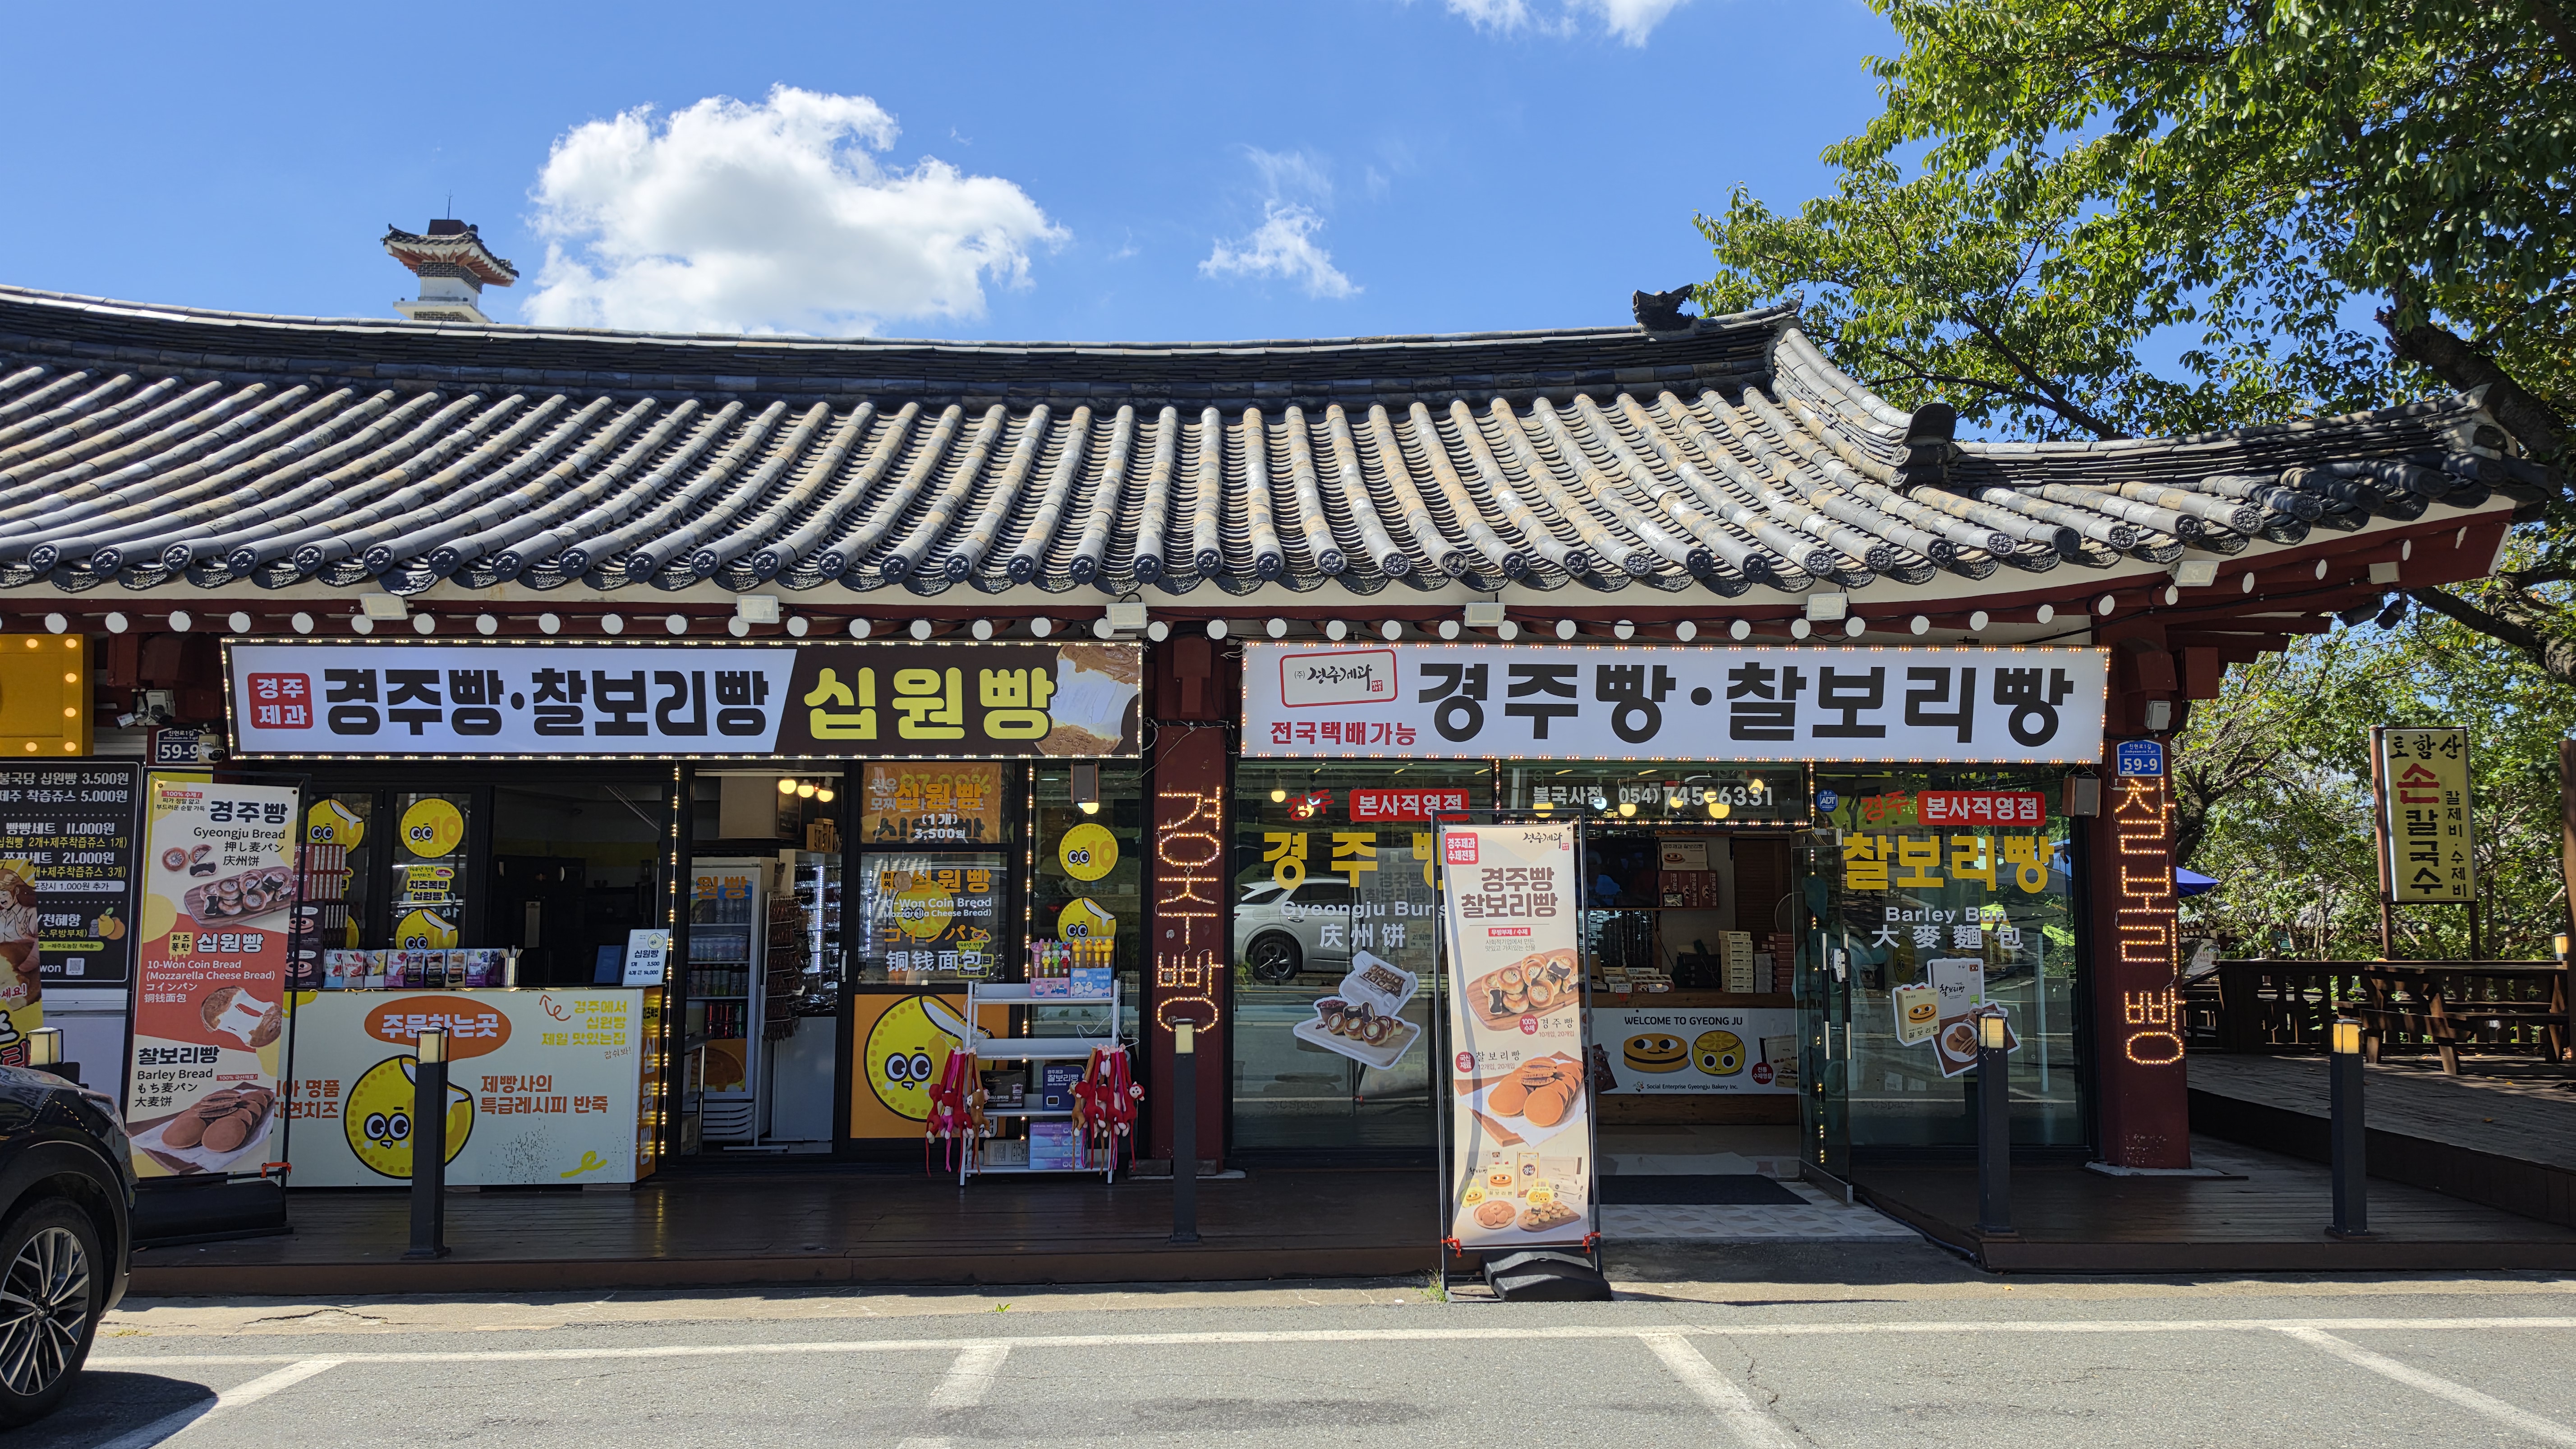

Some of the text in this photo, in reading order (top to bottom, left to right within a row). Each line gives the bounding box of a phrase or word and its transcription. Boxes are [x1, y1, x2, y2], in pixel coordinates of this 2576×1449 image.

[1306, 663, 1373, 692] 경주제과
[257, 678, 304, 700] 경주
[804, 666, 1055, 740] 십원빵
[258, 705, 307, 726] 제과
[1270, 722, 1417, 746] 전국택배가능
[160, 744, 199, 760] 59-9
[2390, 734, 2463, 760] 토함산
[2124, 758, 2158, 771] 59-9
[40, 772, 78, 785] 십원빵
[82, 772, 129, 785] 3.500원
[26, 790, 76, 803] 착즙쥬스
[81, 790, 128, 803] 5.000원
[894, 783, 983, 809] 십원빵
[1533, 786, 1603, 805] 불국사점
[1820, 796, 1835, 804] ADT
[210, 800, 288, 824] 경주빵
[1286, 789, 1334, 821] 경주
[1358, 794, 1463, 816] 본사직영점
[1860, 790, 1910, 821] 경주
[1926, 797, 2038, 820] 본사직영점
[6, 822, 115, 835] 빵빵세트 11.000원
[193, 826, 285, 840] Gyeongju Bread
[914, 828, 966, 840] 3,500원
[2396, 762, 2443, 895] 손칼국수
[110, 836, 127, 849] 1개)
[224, 841, 284, 853] 押し麦パン
[1447, 837, 1476, 849] 경주제과
[1522, 832, 1563, 849] 경주제과
[62, 851, 115, 865] 21.000원
[223, 855, 260, 867] 庆州饼
[1448, 849, 1476, 861] 수제전통
[1843, 832, 2055, 894] 찰보리빵
[107, 866, 126, 878] 3개)
[60, 882, 90, 891] 1.000원
[92, 882, 109, 891] 추가
[409, 880, 448, 890] 치즈폭탄
[911, 869, 992, 893] 십원빵
[1481, 867, 1555, 892] 경주빵
[413, 891, 442, 901] 십원빵
[880, 897, 992, 909] 10-Won Coin Bread
[1280, 901, 1385, 919] Gyeongju
[1461, 892, 1558, 918] 찰보리빵
[963, 909, 992, 918] Bread)
[1886, 906, 2008, 924] Barley Bun
[884, 924, 987, 944] コインパン
[1320, 923, 1406, 948] 庆州饼
[171, 942, 190, 952] 폭탄
[196, 932, 264, 953] 십원빵
[634, 950, 659, 958] 십원빵
[886, 950, 982, 972] 铜钱面包
[147, 960, 242, 969] 10-Won Coin Bread
[146, 970, 276, 981] (Mozzarella Cheese Bread)
[146, 983, 198, 992] コインパン
[144, 993, 187, 1003] 铜钱面包
[574, 1001, 627, 1014] 경주에서
[381, 1013, 498, 1038] 주문하는곳
[586, 1016, 627, 1030] 십원빵
[1540, 1017, 1574, 1029] 경주빵
[1624, 1016, 1743, 1025] WELCOME TO GYEONG JU
[542, 1033, 626, 1046] 제일 맛있는집
[138, 1046, 220, 1065] 찰보리빵
[1476, 1050, 1521, 1062] 찰보리빵
[137, 1068, 213, 1081] Barley Bread
[1047, 1074, 1079, 1082] 찰보리빵
[138, 1082, 198, 1094] もち麦パン
[305, 1080, 340, 1098] 명품
[480, 1075, 552, 1094] 제빵사의
[135, 1096, 173, 1108] 大麦饼
[480, 1095, 608, 1114] 특급레시피 반죽
